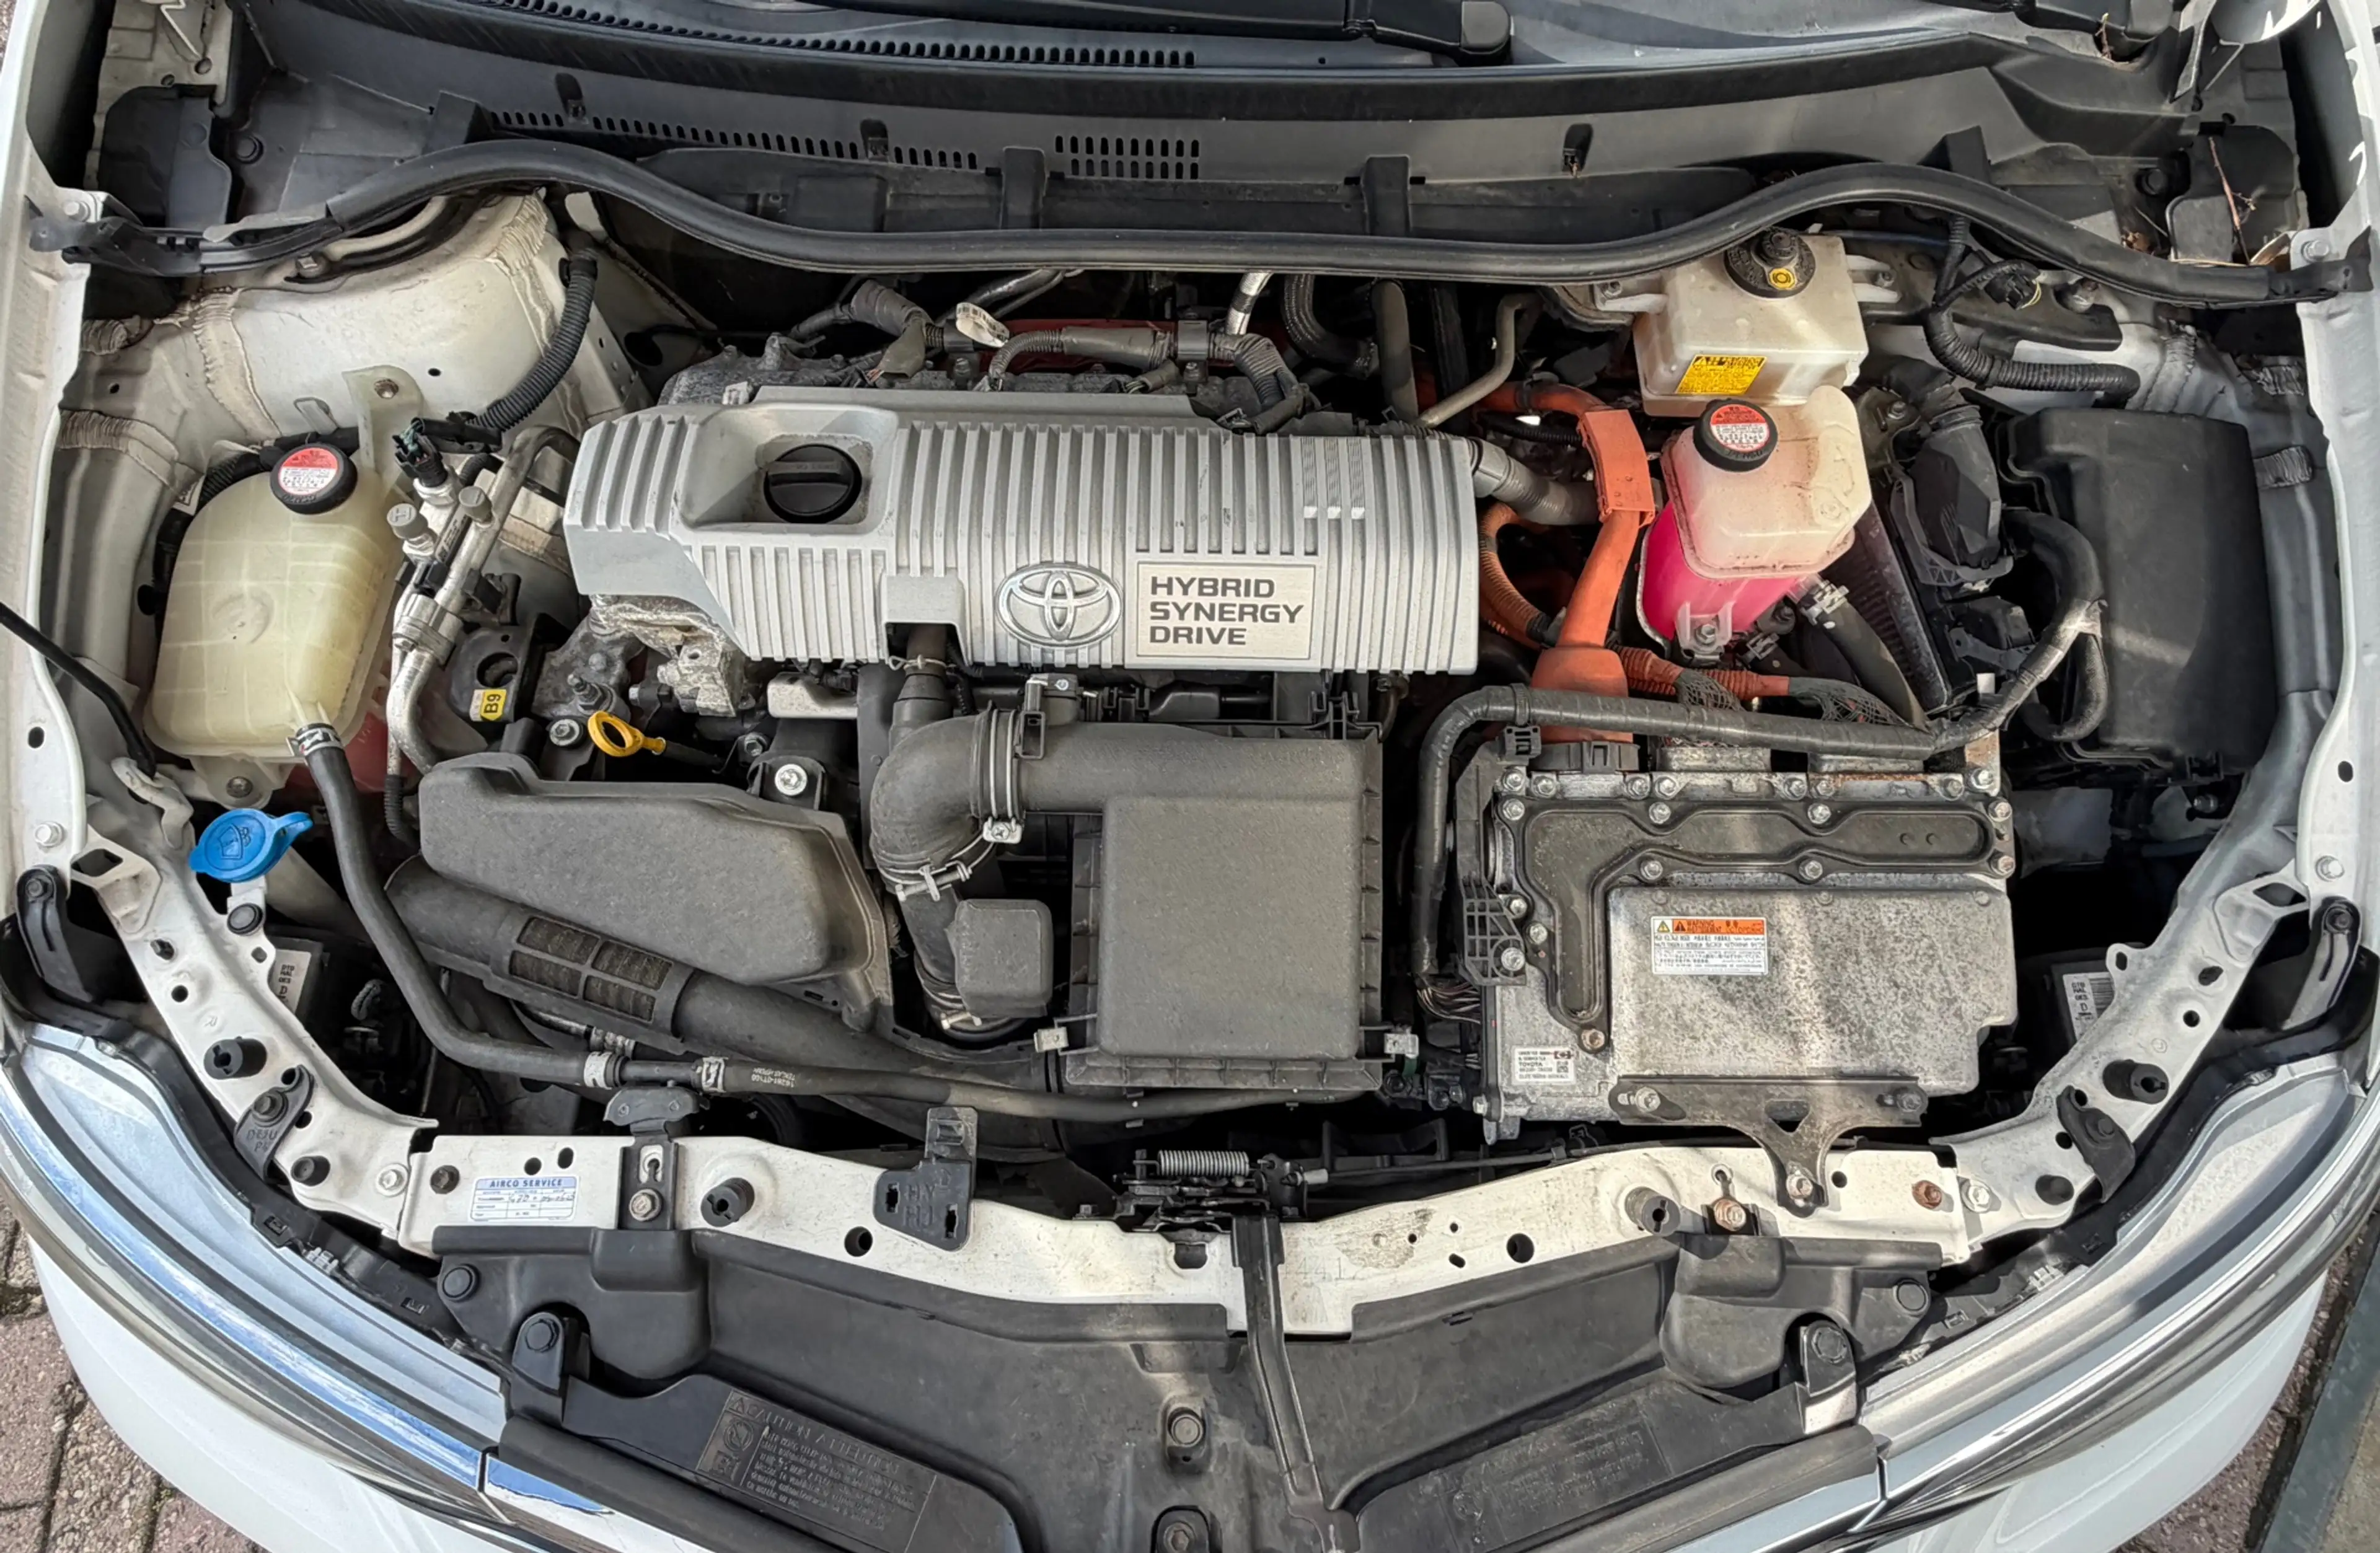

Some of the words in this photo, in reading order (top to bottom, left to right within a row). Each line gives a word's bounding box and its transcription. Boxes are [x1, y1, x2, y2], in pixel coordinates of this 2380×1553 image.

[1150, 576, 1276, 599] HYBRID
[1149, 601, 1304, 624] SYNERGY
[1149, 626, 1247, 646] DRIVE
[483, 693, 501, 714] B9
[489, 1179, 519, 1188] AIRCO
[522, 1178, 563, 1187] SERVICE
[744, 1402, 812, 1440] CAUTION
[815, 1432, 900, 1476] ATTENTION
